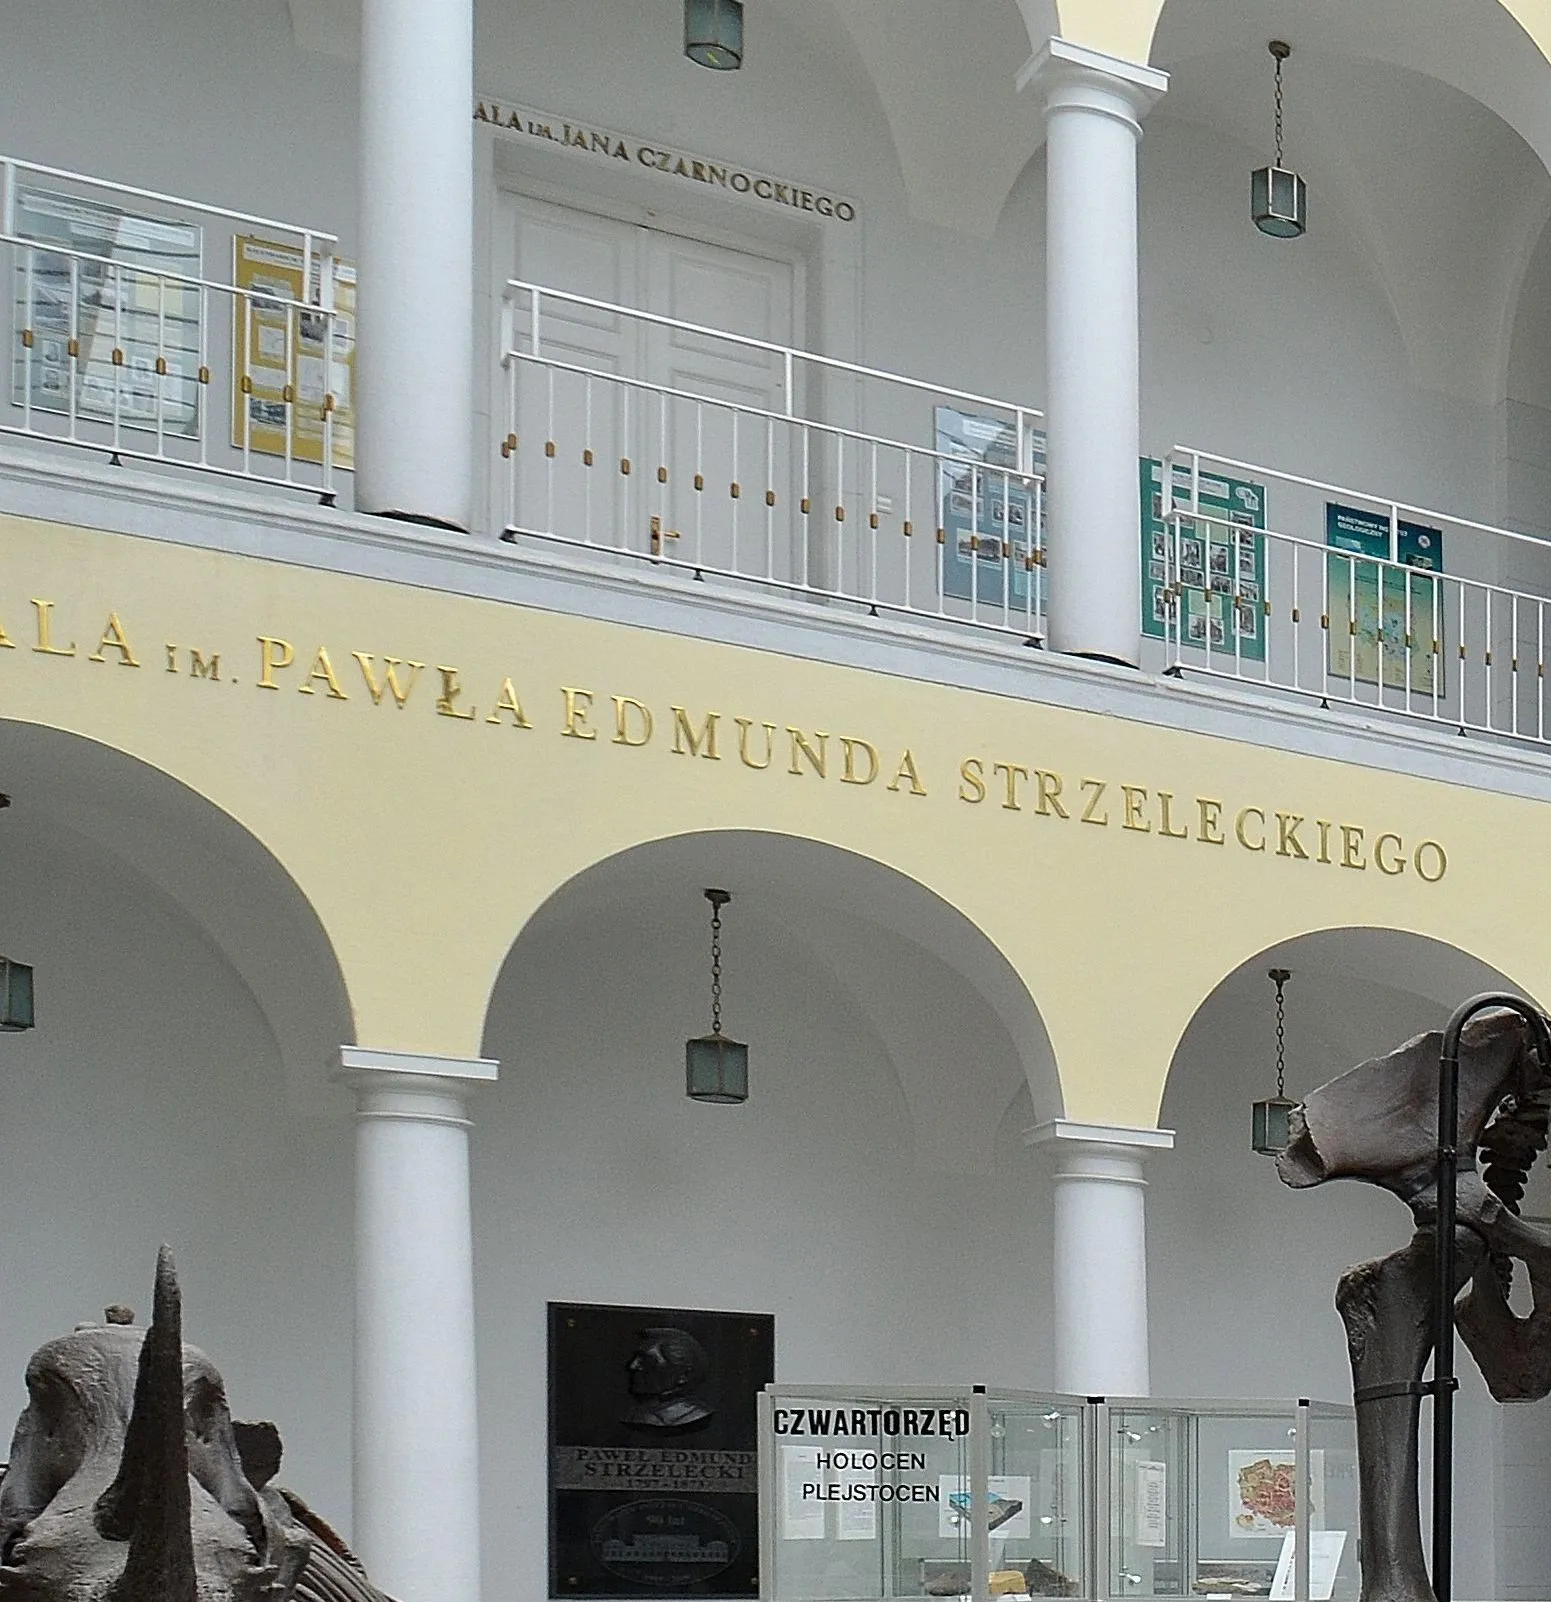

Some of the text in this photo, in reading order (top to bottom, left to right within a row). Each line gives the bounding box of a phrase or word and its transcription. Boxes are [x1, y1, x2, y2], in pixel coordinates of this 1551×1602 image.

[562, 118, 630, 162] JANA
[637, 146, 856, 222] CZARNOCKIEGO
[256, 635, 533, 730] PAWŁA
[559, 686, 927, 797] EDMUNDA
[958, 756, 1448, 882] STRZELECKIEGO
[774, 1408, 970, 1442] CZWARTORZĘD
[661, 1450, 750, 1465] EDMUND
[816, 1451, 926, 1471] HOLOCEN
[584, 1462, 744, 1479] STRZELECKI
[802, 1482, 941, 1503] PLEJSTOCEN
